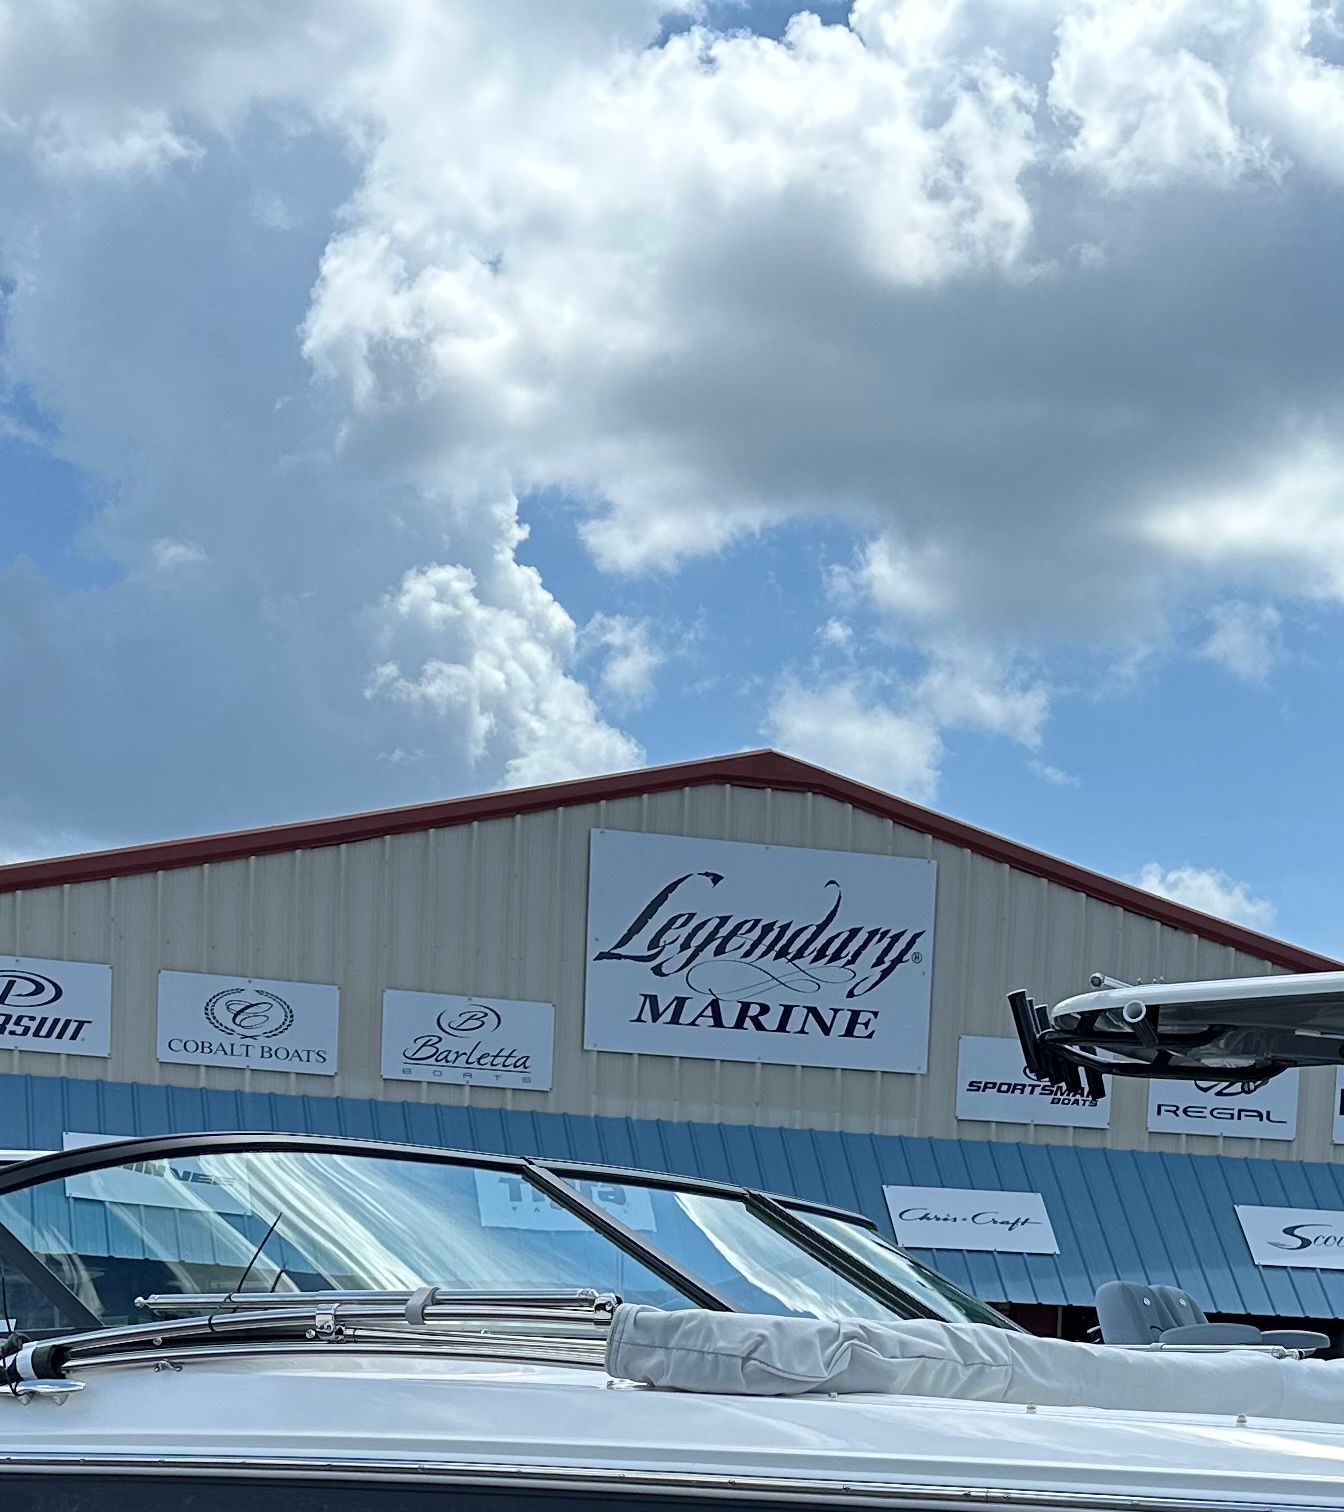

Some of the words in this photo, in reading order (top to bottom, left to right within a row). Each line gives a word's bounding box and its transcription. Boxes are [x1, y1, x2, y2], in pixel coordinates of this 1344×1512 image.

[593, 871, 927, 998] Legendary
[629, 993, 880, 1040] MARINE
[167, 1038, 255, 1058] COBALT
[259, 1045, 328, 1064] BOATS
[402, 1034, 532, 1070] Barletta
[1049, 1097, 1099, 1108] BOATS
[1156, 1103, 1288, 1124] REGAL
